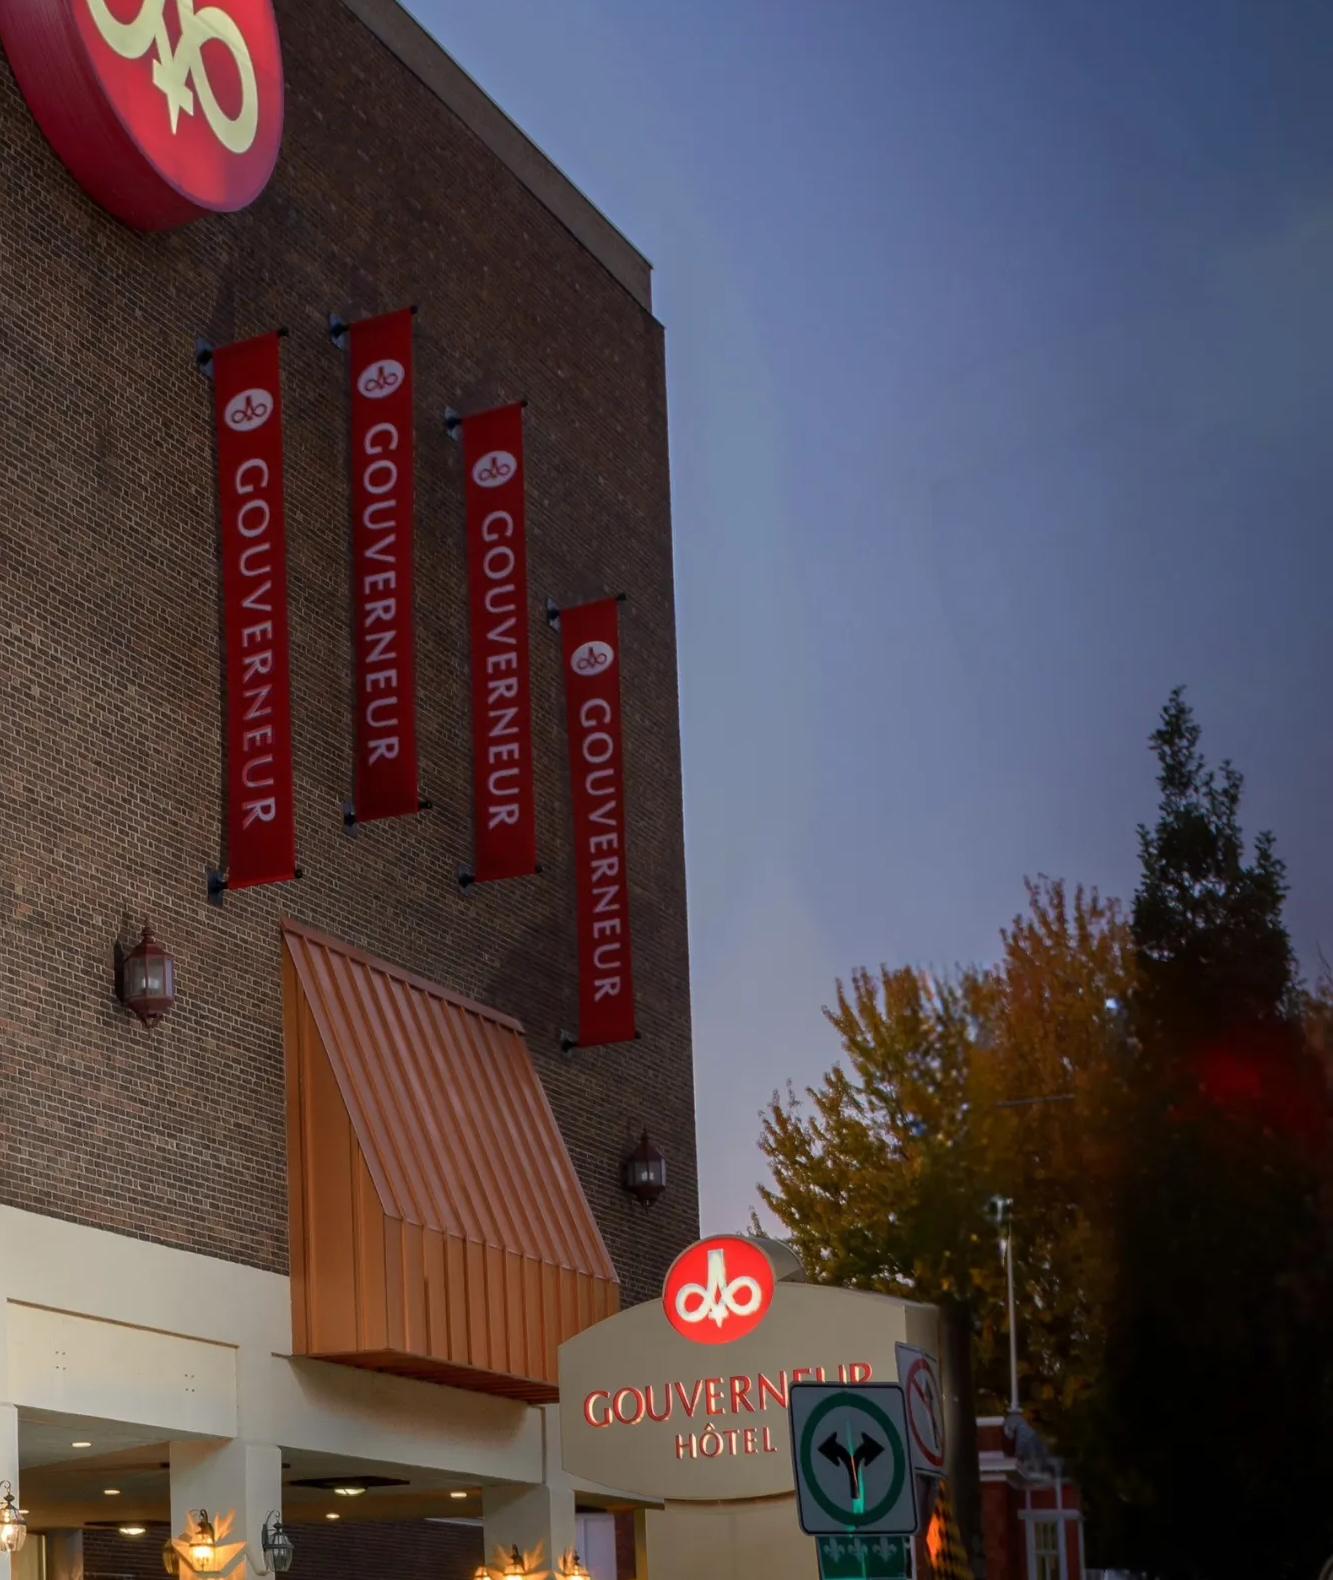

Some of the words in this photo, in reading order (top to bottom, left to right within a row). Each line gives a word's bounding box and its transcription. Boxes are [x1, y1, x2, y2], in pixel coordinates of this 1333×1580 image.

[235, 457, 276, 828] GOUVERNEUR
[362, 423, 400, 766] GOUVERNEUR
[481, 509, 521, 831] GOUVERNEUR
[579, 697, 622, 1002] GOUVERNEUR
[674, 1422, 778, 1460] HÔTEL
